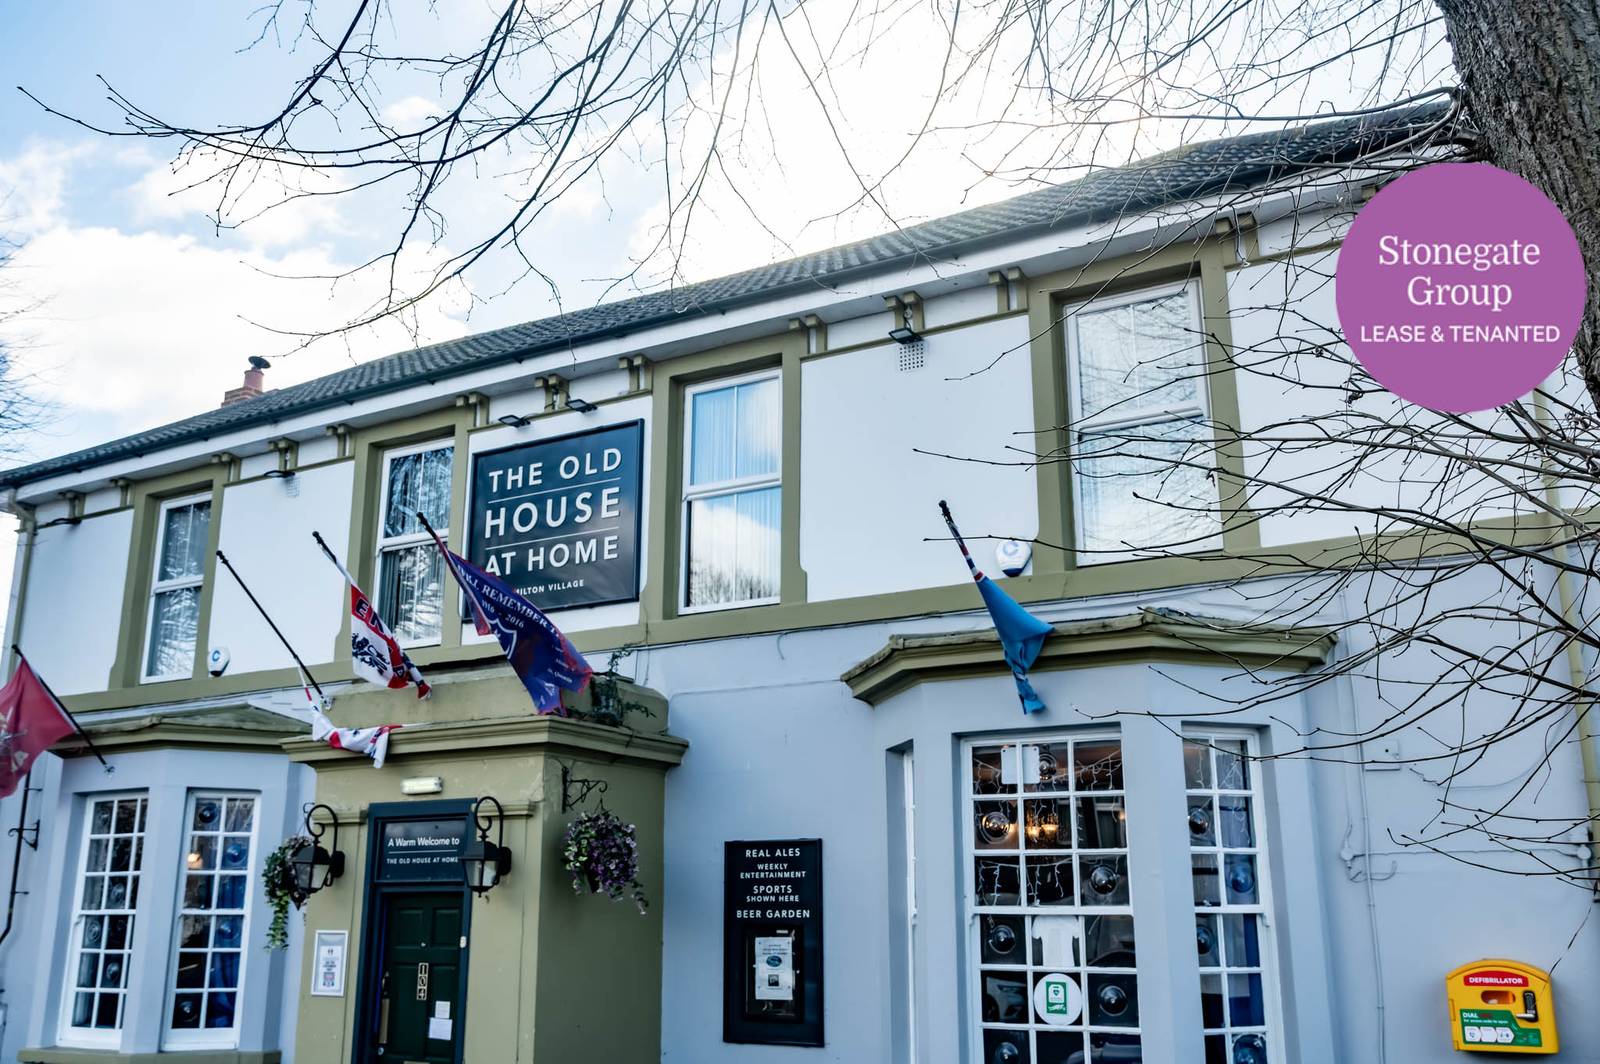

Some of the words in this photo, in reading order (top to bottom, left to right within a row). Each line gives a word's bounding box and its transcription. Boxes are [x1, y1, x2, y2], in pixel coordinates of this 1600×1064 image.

[488, 462, 544, 493] THE
[559, 447, 622, 480] OLD
[484, 486, 621, 539] HOUSE
[485, 551, 517, 577] AT
[527, 535, 619, 572] HOME
[548, 579, 585, 592] VILLAGE
[481, 584, 550, 628] REMEMBER
[505, 614, 525, 628] 2016
[387, 838, 395, 847] A
[395, 838, 416, 847] Warm
[417, 837, 450, 847] Welcome
[451, 837, 460, 845] to
[745, 849, 771, 858] REAL
[775, 847, 801, 857] ALES
[399, 857, 411, 865] OLD
[740, 871, 806, 879] ENTERTAINMENT
[753, 885, 793, 894] SPORTS
[736, 909, 762, 918] BEER
[766, 909, 811, 918] GARDEN
